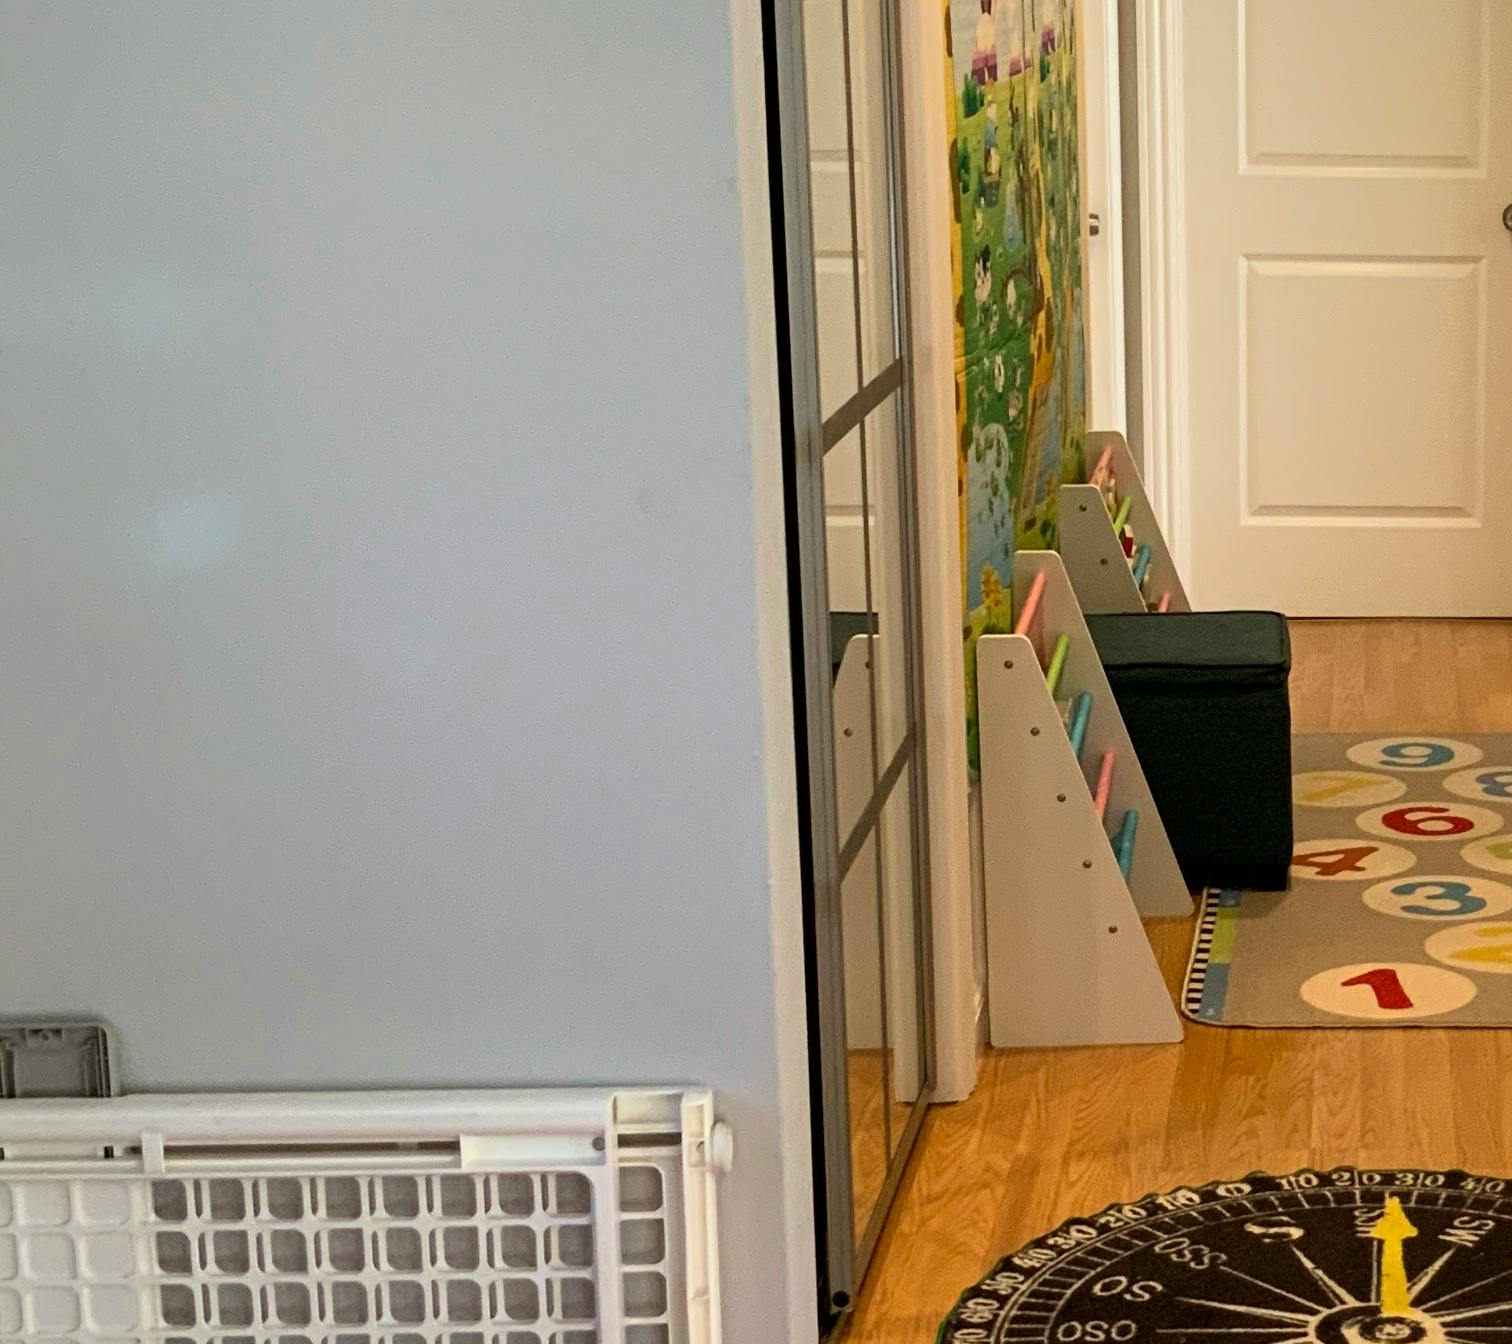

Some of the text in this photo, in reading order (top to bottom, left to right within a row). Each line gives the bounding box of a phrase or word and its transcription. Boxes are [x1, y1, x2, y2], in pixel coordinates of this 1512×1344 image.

[1379, 741, 1455, 767] 9
[1299, 775, 1387, 803] 7
[1381, 805, 1474, 836] 6
[1293, 845, 1379, 876] 4
[1391, 880, 1486, 916] 3
[1341, 968, 1413, 1009] 1
[1331, 1171, 1381, 1186] 20
[1395, 1172, 1446, 1187] 30
[1092, 1275, 1164, 1303] SO
[1057, 1319, 1137, 1342] OSO
